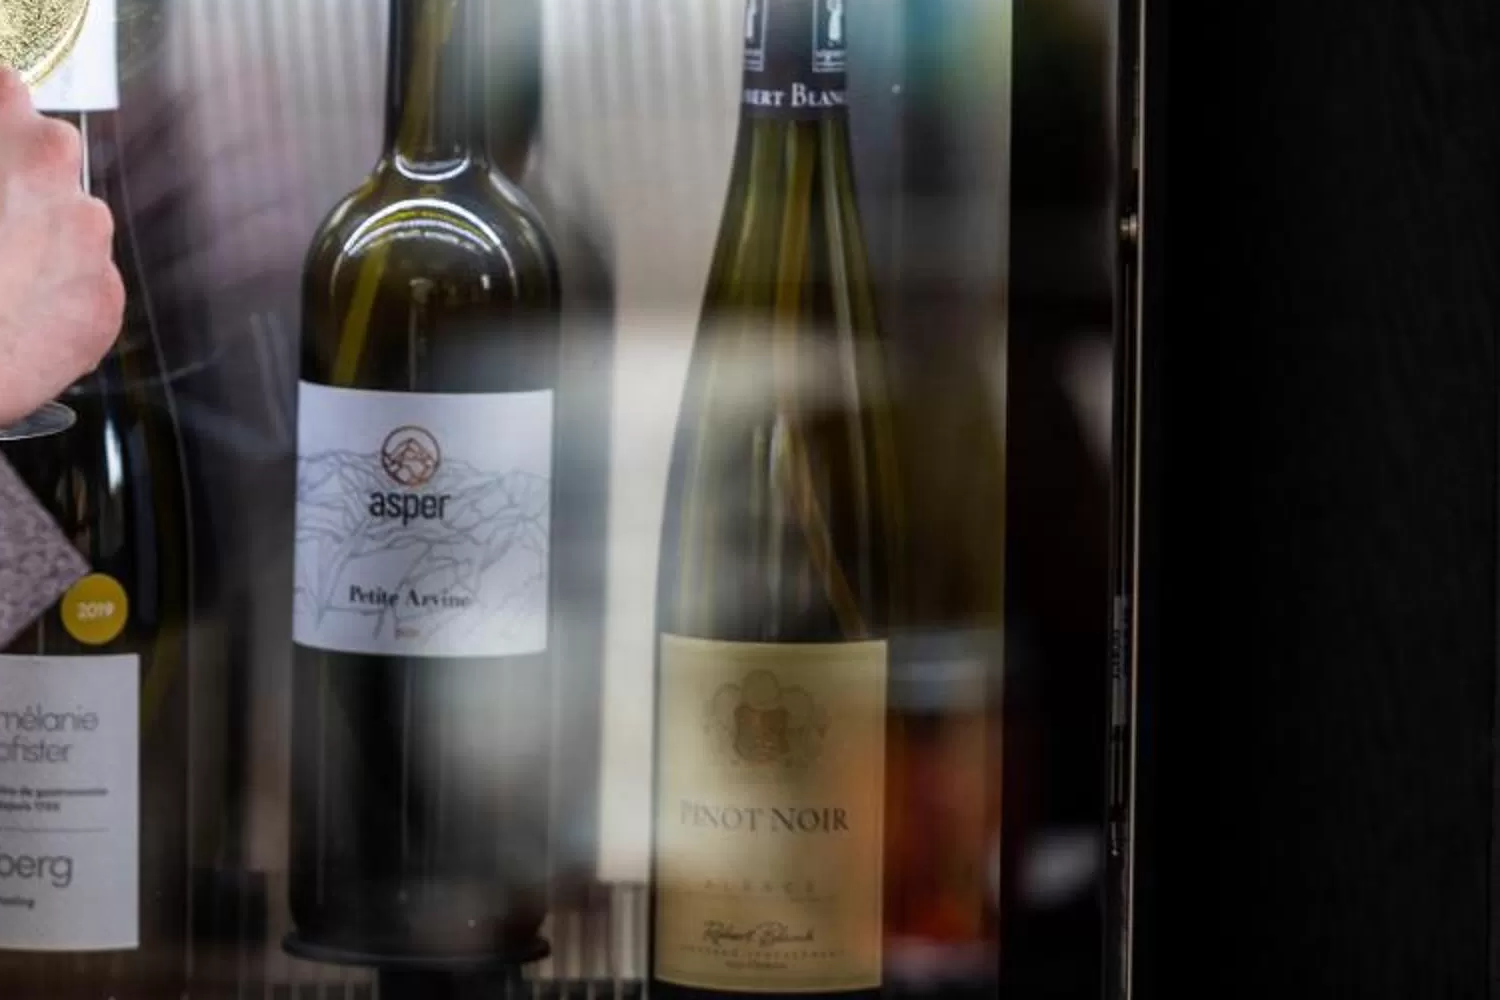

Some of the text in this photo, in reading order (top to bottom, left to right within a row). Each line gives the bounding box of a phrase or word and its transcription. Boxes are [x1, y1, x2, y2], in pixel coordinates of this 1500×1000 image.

[368, 491, 452, 527] asper
[349, 584, 399, 608] Petite
[76, 602, 115, 621] 2019
[678, 798, 850, 834] PINOT NOIR
